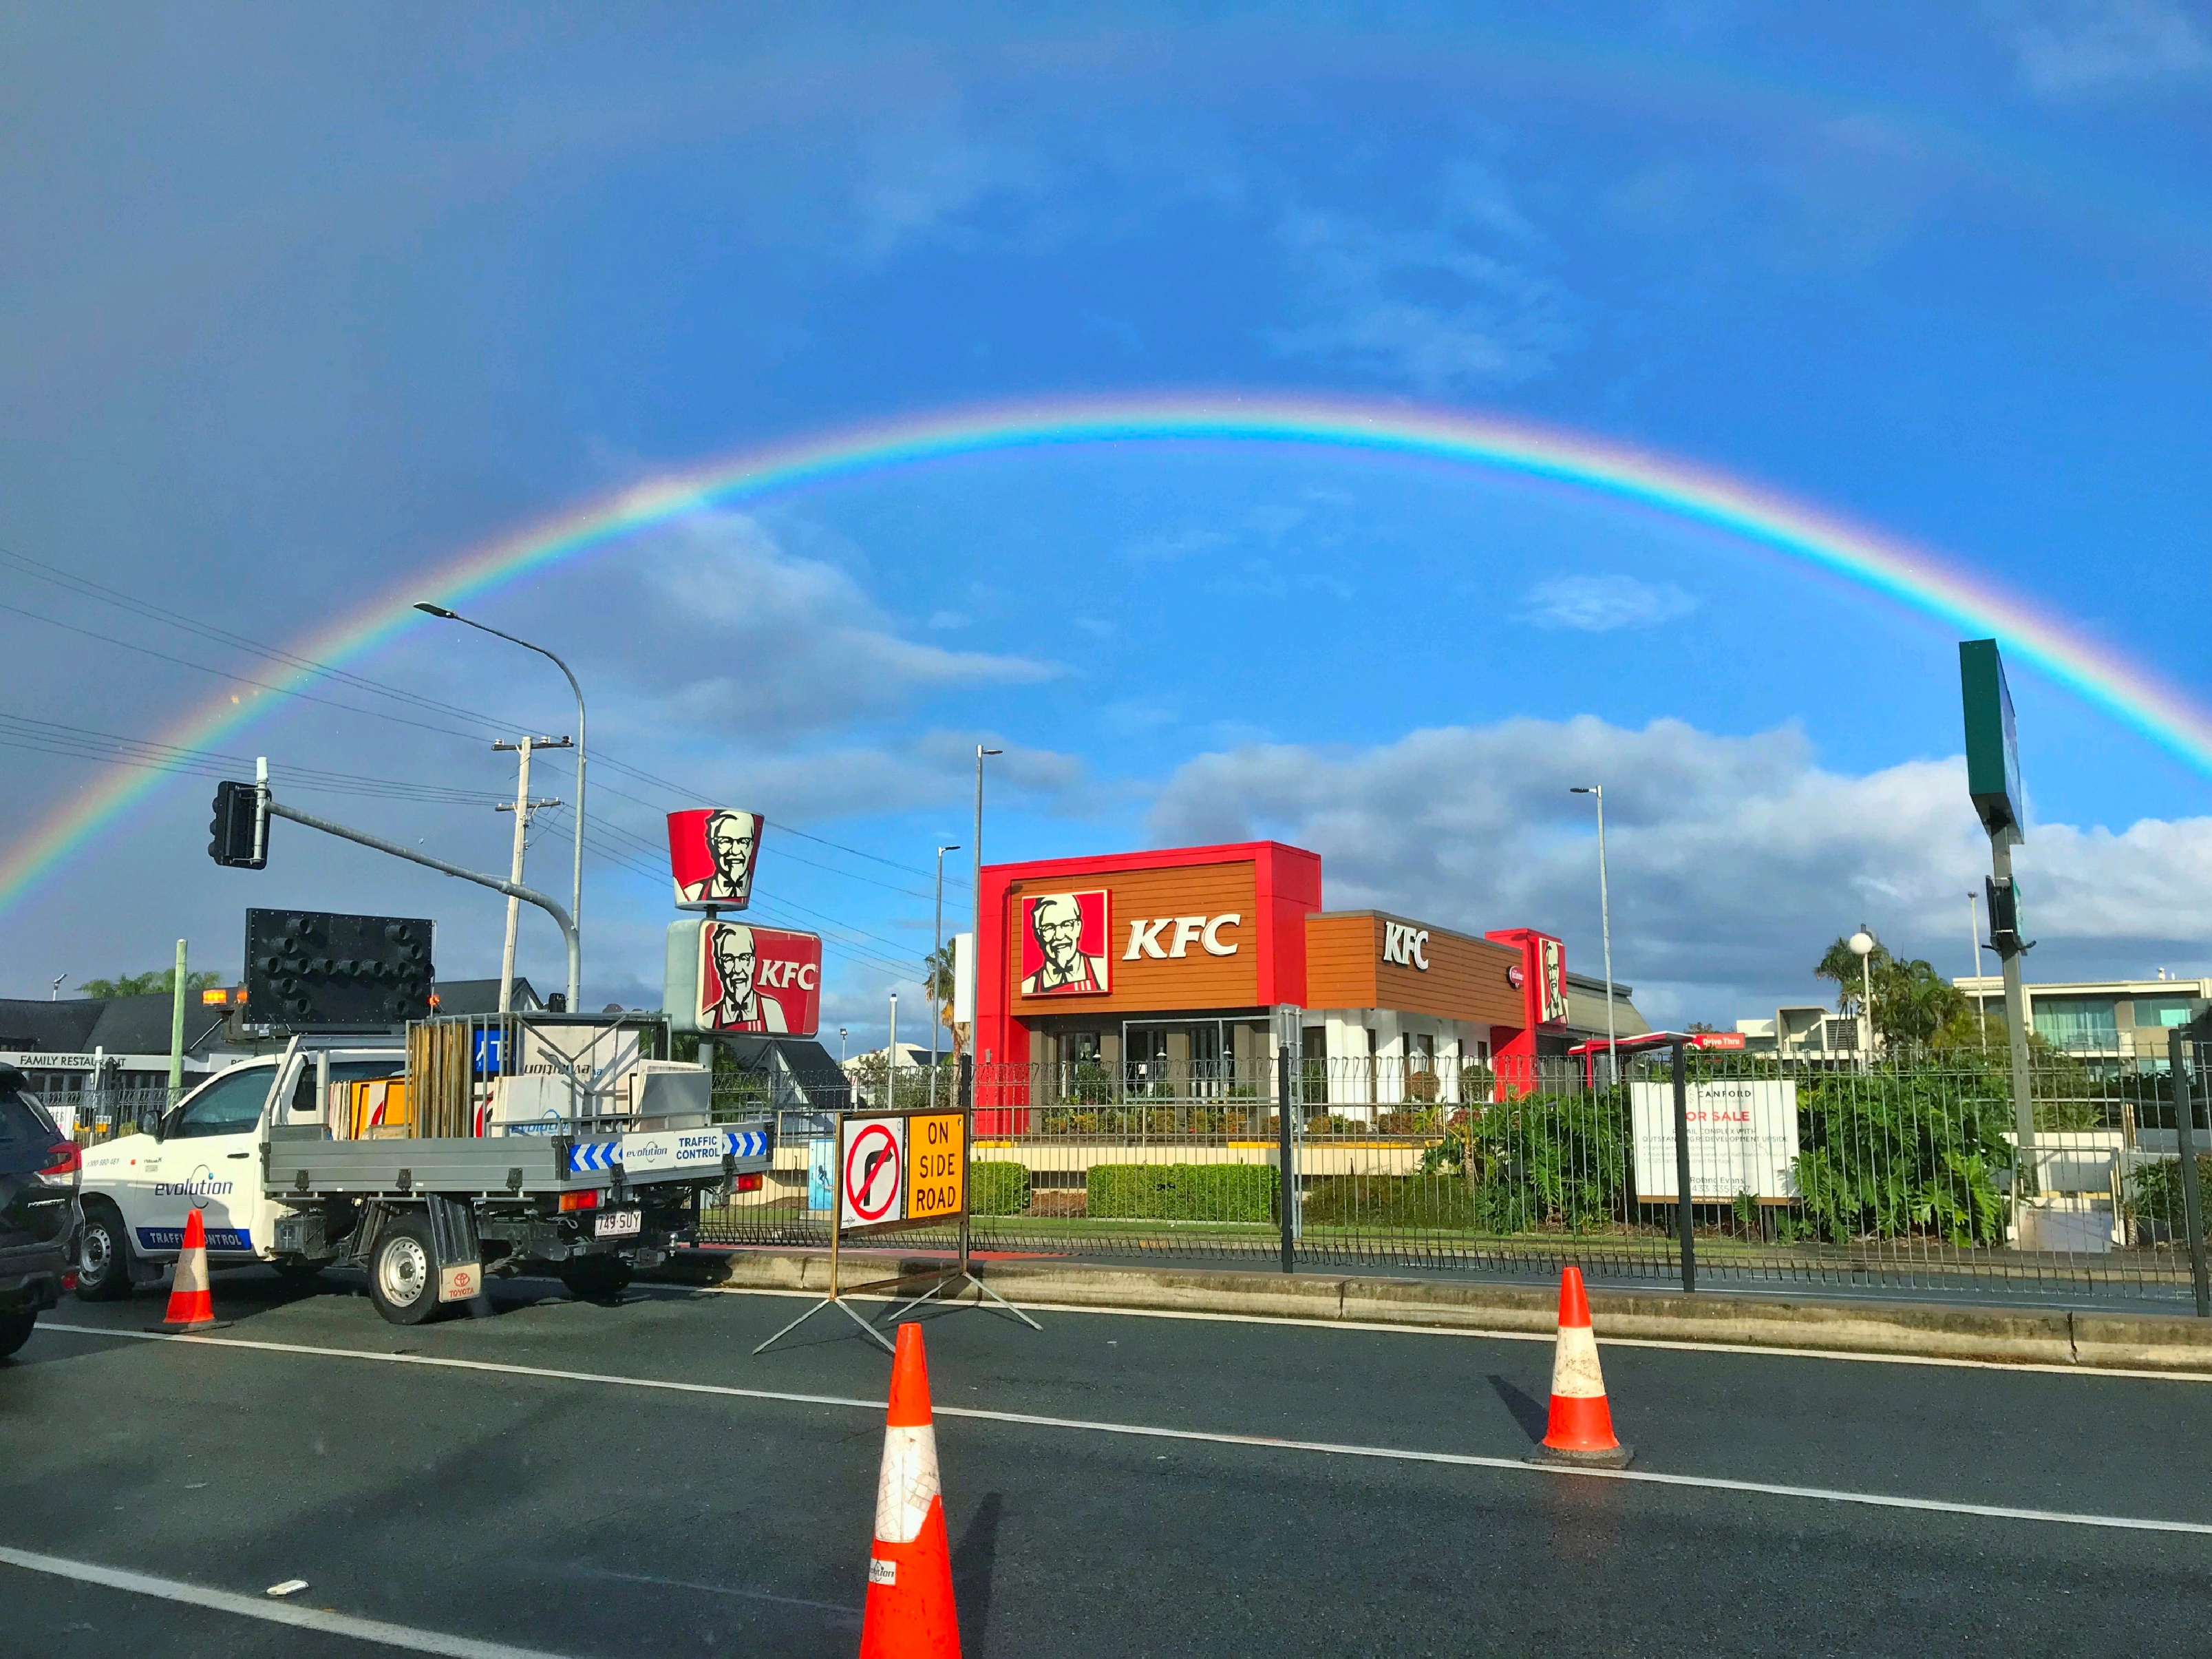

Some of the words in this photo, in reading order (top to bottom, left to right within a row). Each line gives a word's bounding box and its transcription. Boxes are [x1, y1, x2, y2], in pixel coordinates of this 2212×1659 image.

[1122, 913, 1242, 961] KFC
[1383, 921, 1429, 971] KFC
[757, 959, 817, 991] KFC
[20, 1055, 58, 1066] FAMILY
[1685, 1111, 1707, 1122] OR
[1712, 1110, 1750, 1122] SALE
[928, 1121, 948, 1145] ON
[679, 1136, 717, 1148] TRAFFIC
[626, 1148, 668, 1158] evolution
[676, 1148, 721, 1160] CONTROL
[919, 1153, 955, 1179] SIDE
[155, 1179, 233, 1196] evolution
[916, 1185, 956, 1212] ROAD
[150, 1232, 184, 1244] TRAFFI
[204, 1234, 242, 1246] ONTROL
[449, 1287, 474, 1298] TOYOTA
